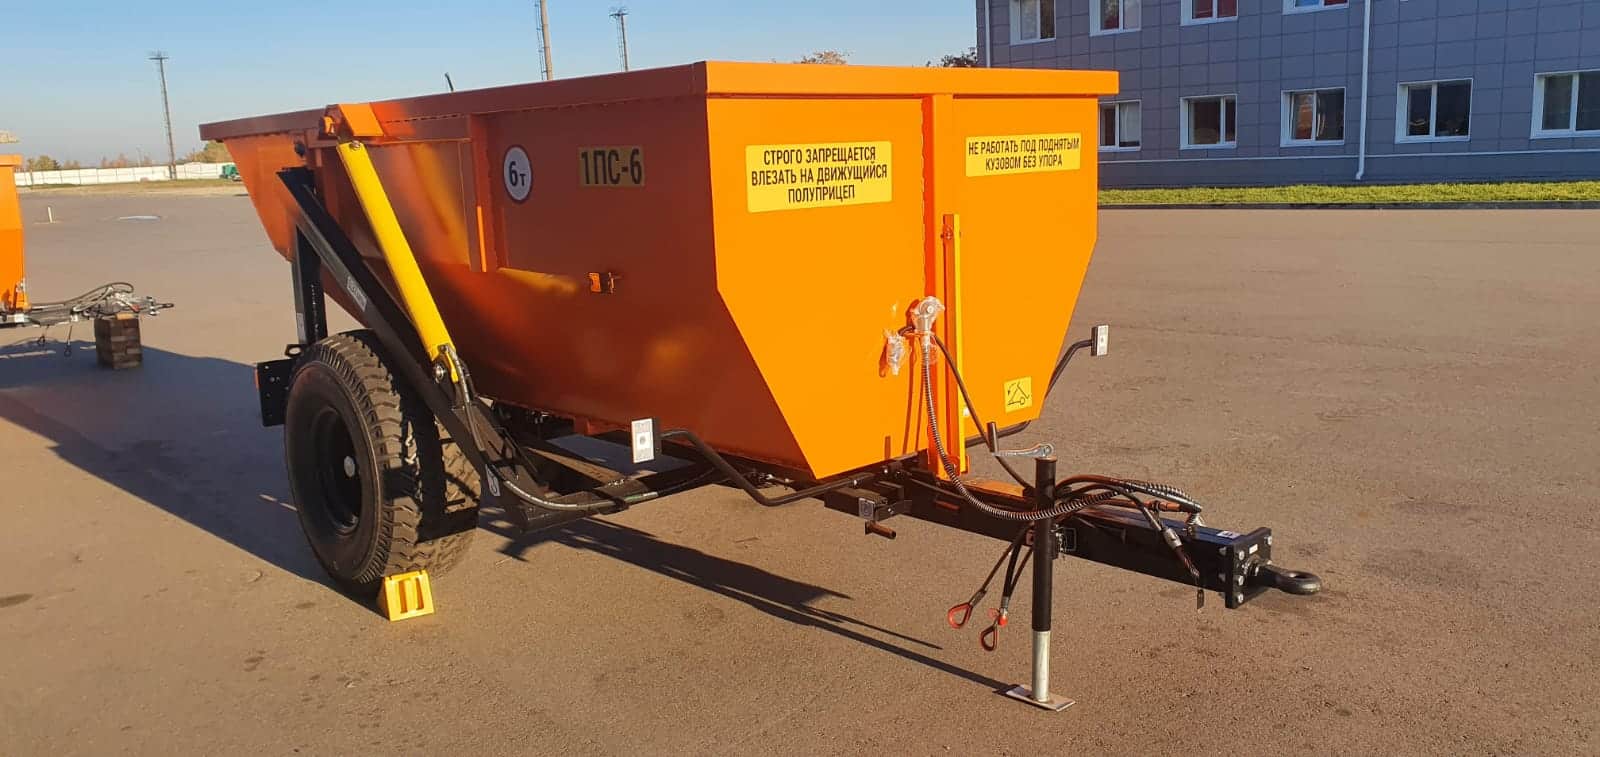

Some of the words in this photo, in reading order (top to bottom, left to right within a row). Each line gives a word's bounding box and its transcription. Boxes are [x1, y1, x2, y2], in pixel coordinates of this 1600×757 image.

[764, 149, 802, 165] СТРОГО
[806, 146, 876, 164] ЗАПРЕЩАЕТСЯ
[969, 141, 979, 156] НЕ
[981, 140, 1018, 154] РАБОТАТЬ
[1021, 139, 1036, 154] ПОД
[1039, 138, 1079, 152] ПОДНЯТЫМ
[581, 148, 642, 185] 1ПС-6
[985, 156, 1021, 170] КУЗОВОМ
[1023, 155, 1037, 168] БЕЗ
[1039, 154, 1062, 167] УПОРА
[751, 169, 797, 186] ВЛЕЗАТЬ
[800, 168, 814, 184] НА
[817, 161, 887, 185] ДВИЖУЩИЙСЯ
[788, 184, 855, 203] ПОЛУПРИЦЕП
